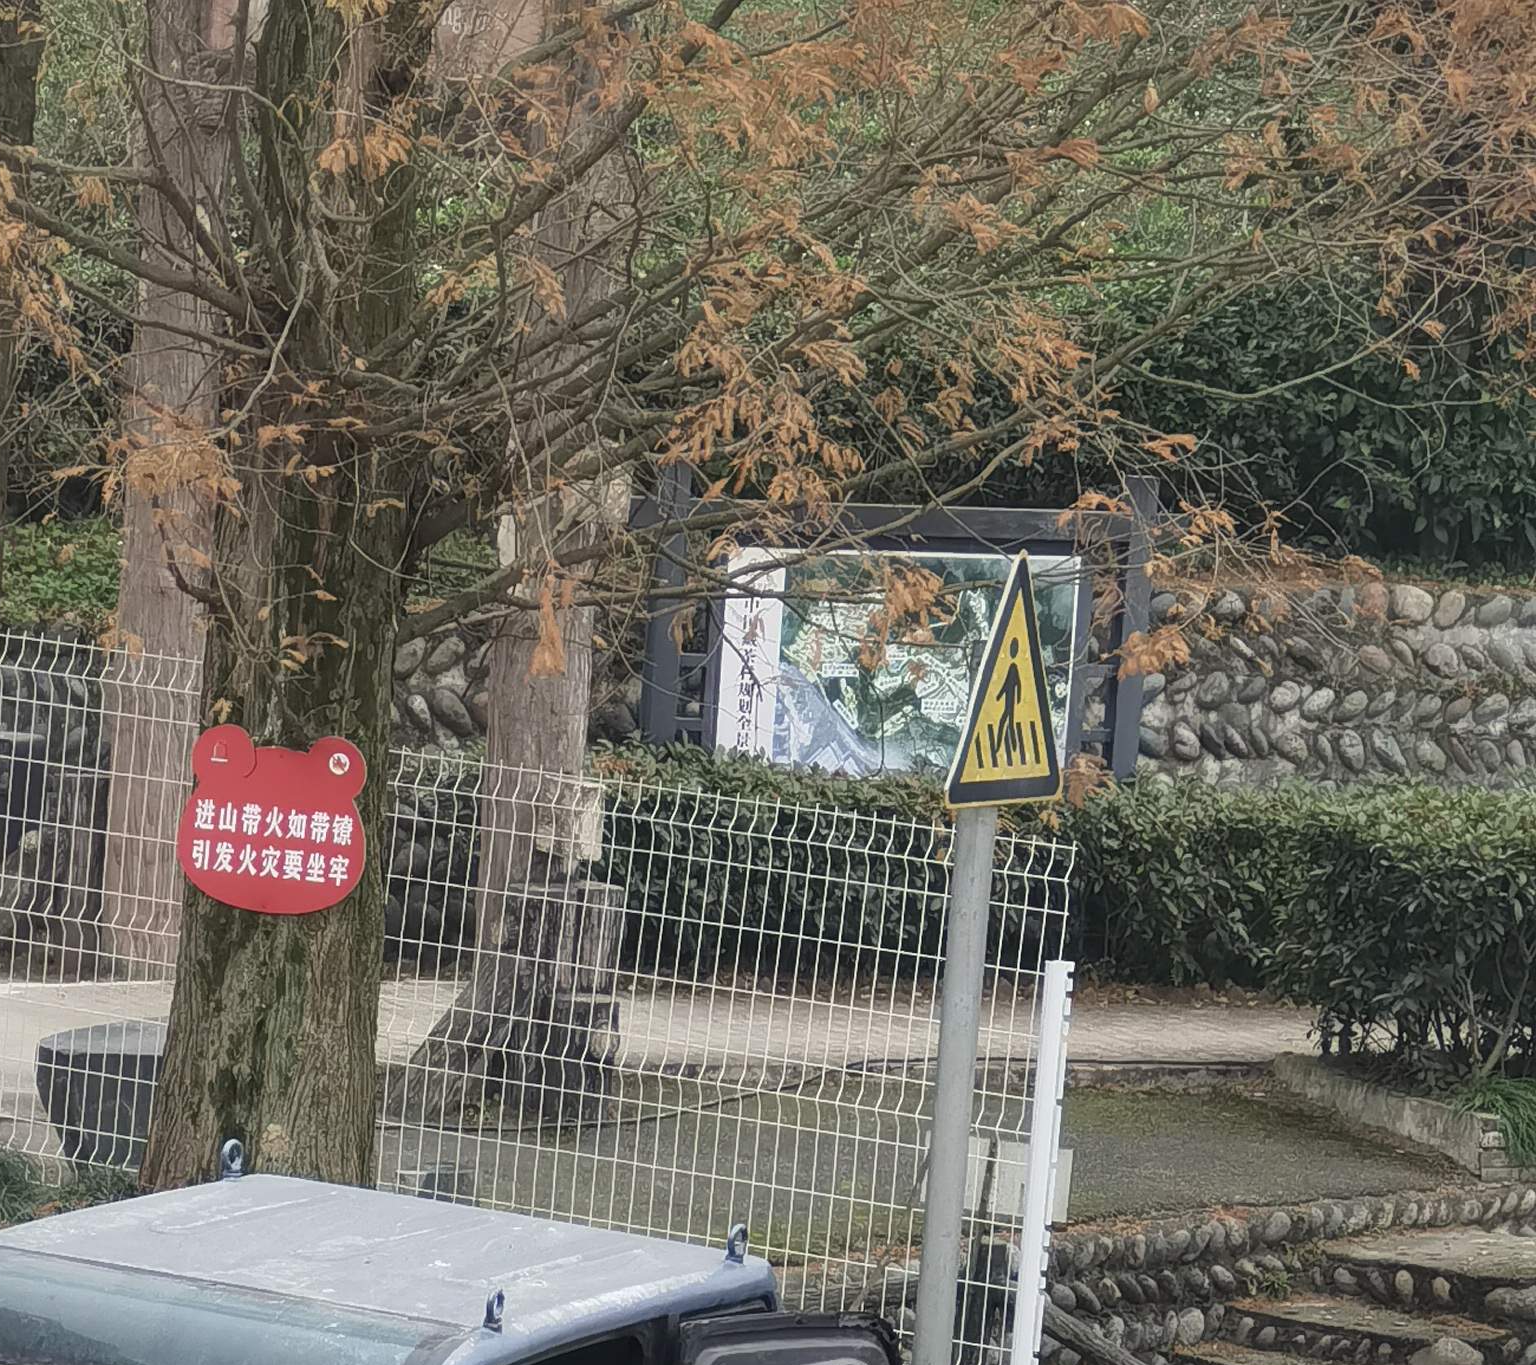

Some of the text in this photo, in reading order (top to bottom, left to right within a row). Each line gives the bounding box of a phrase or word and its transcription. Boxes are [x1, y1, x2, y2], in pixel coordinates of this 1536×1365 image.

[194, 799, 354, 847] 进山带火如带镣
[192, 839, 351, 887] 引发火灾要坐牢
